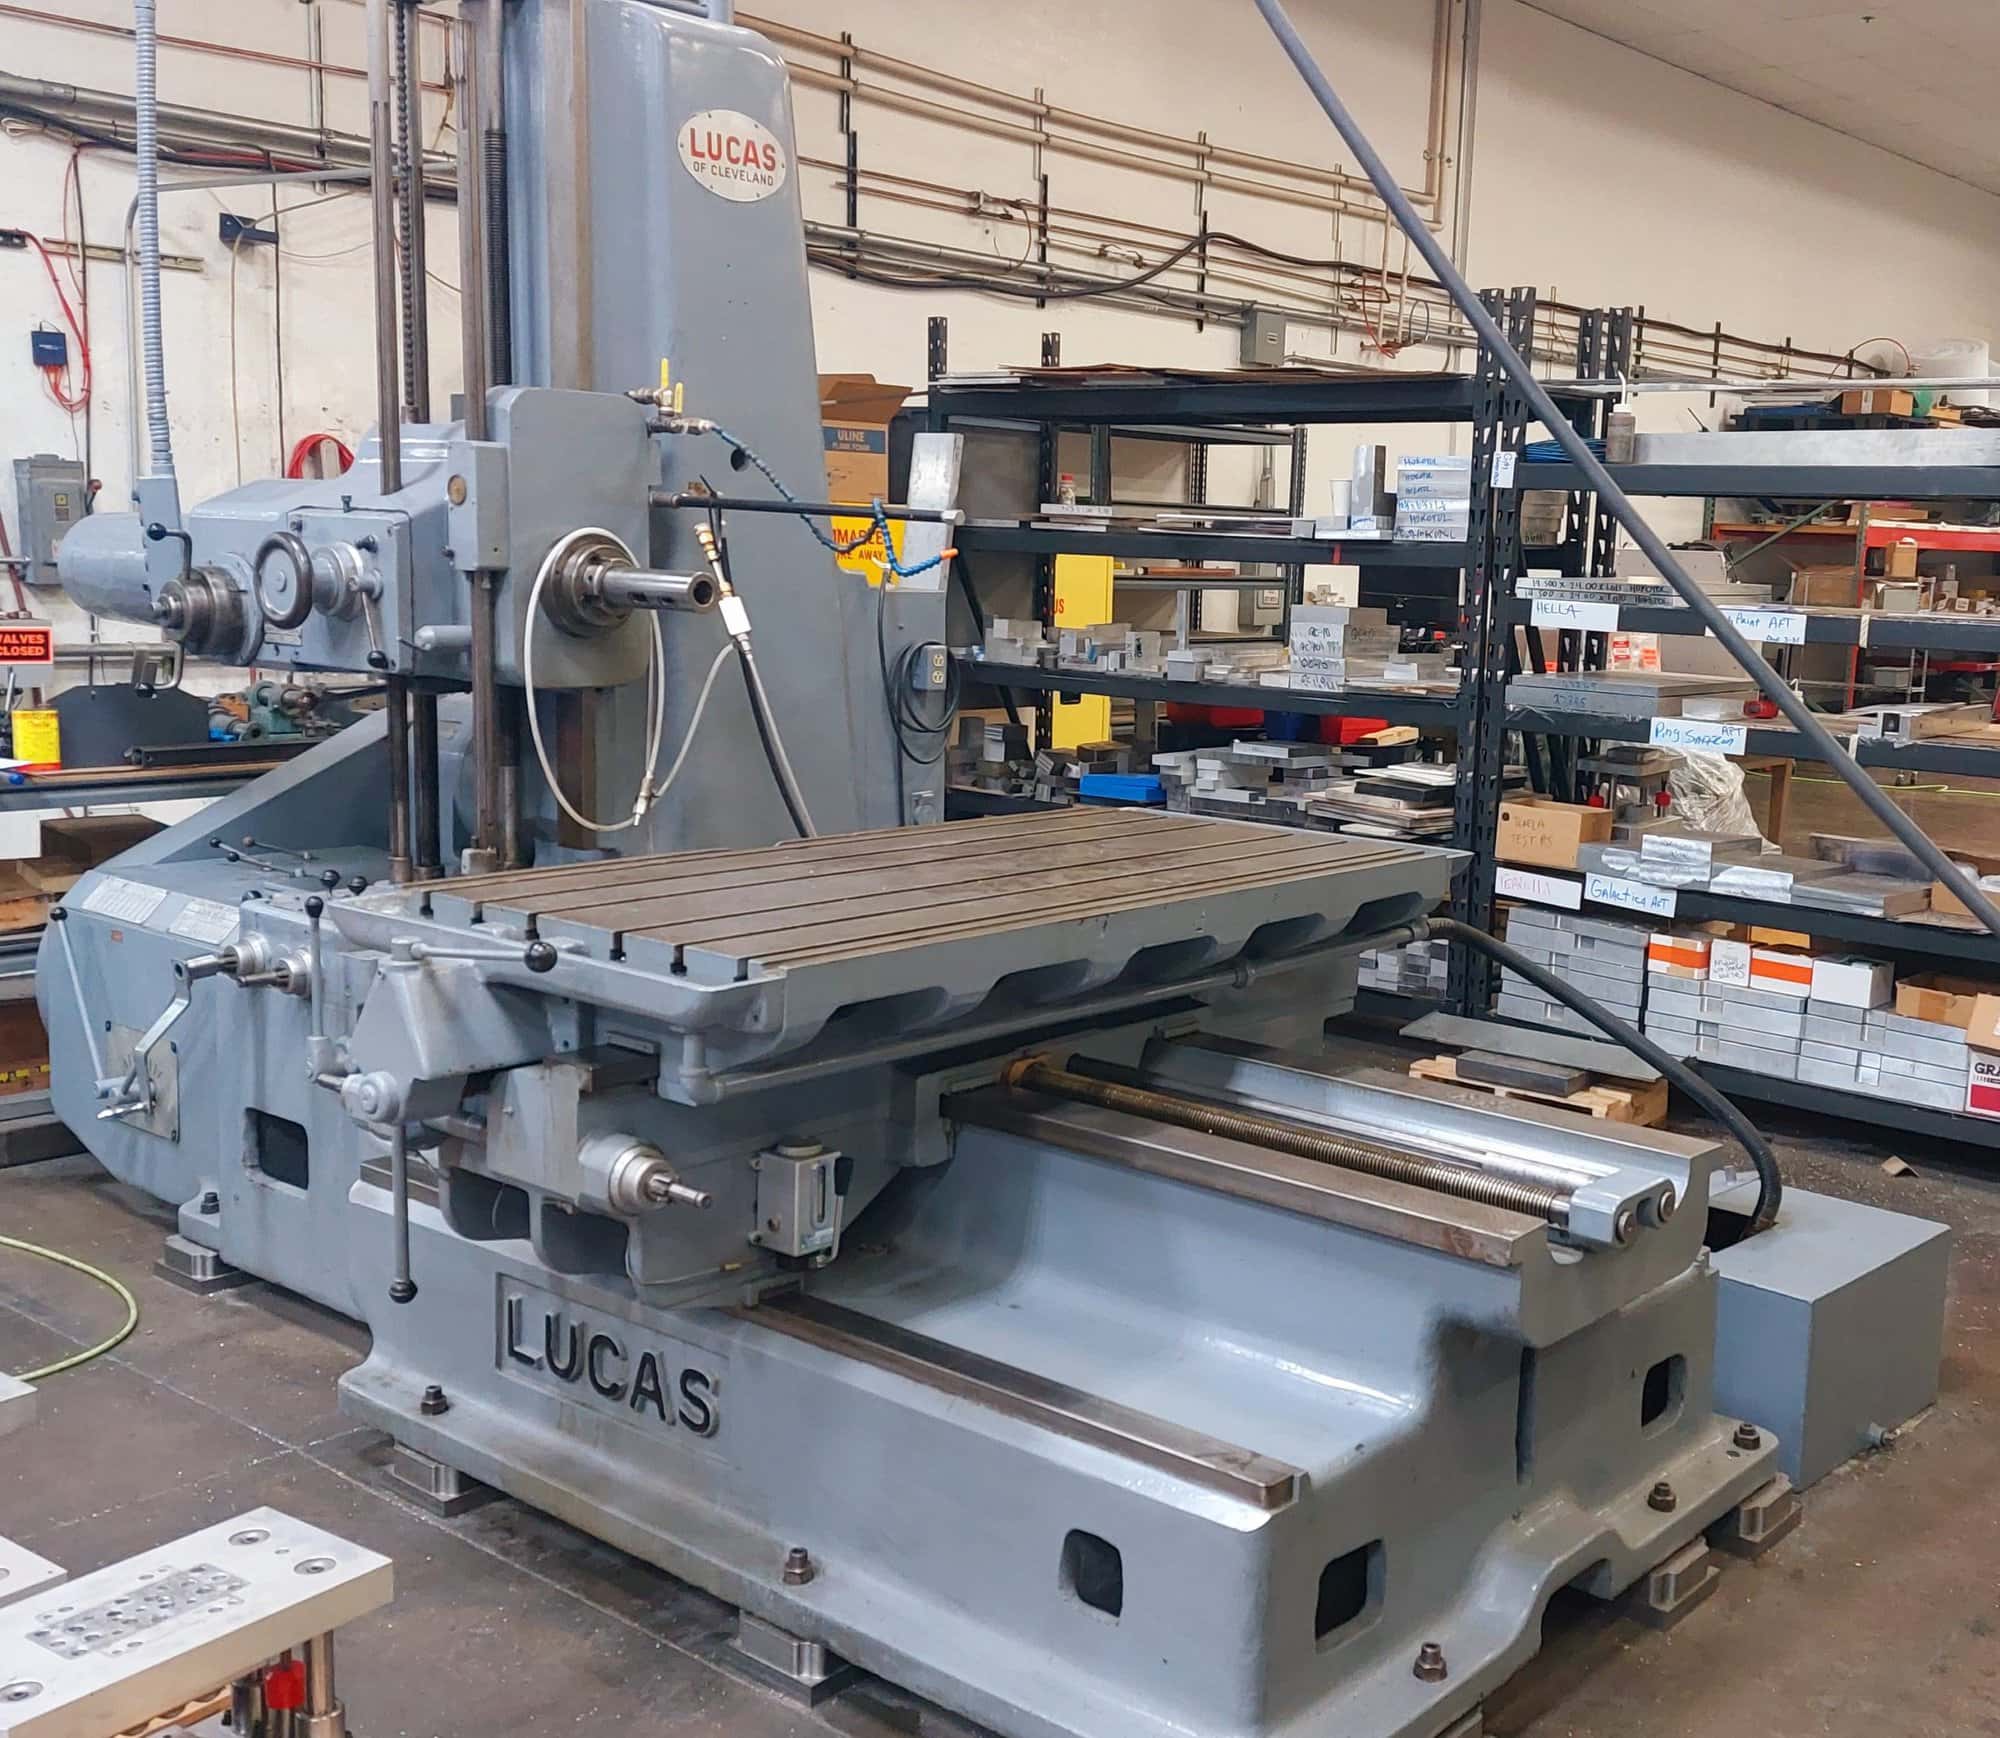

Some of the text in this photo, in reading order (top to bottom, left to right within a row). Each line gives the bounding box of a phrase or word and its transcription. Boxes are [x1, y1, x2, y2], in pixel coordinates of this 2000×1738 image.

[690, 127, 776, 172] LUCAS
[693, 160, 774, 187] OF CLEVELAND
[837, 429, 865, 442] ULINE
[1536, 602, 1579, 620] HELLA
[1768, 616, 1795, 630] AFT
[1655, 721, 1680, 743] Ping
[1974, 1061, 2000, 1077] GR
[507, 1295, 720, 1439] LUCAS
